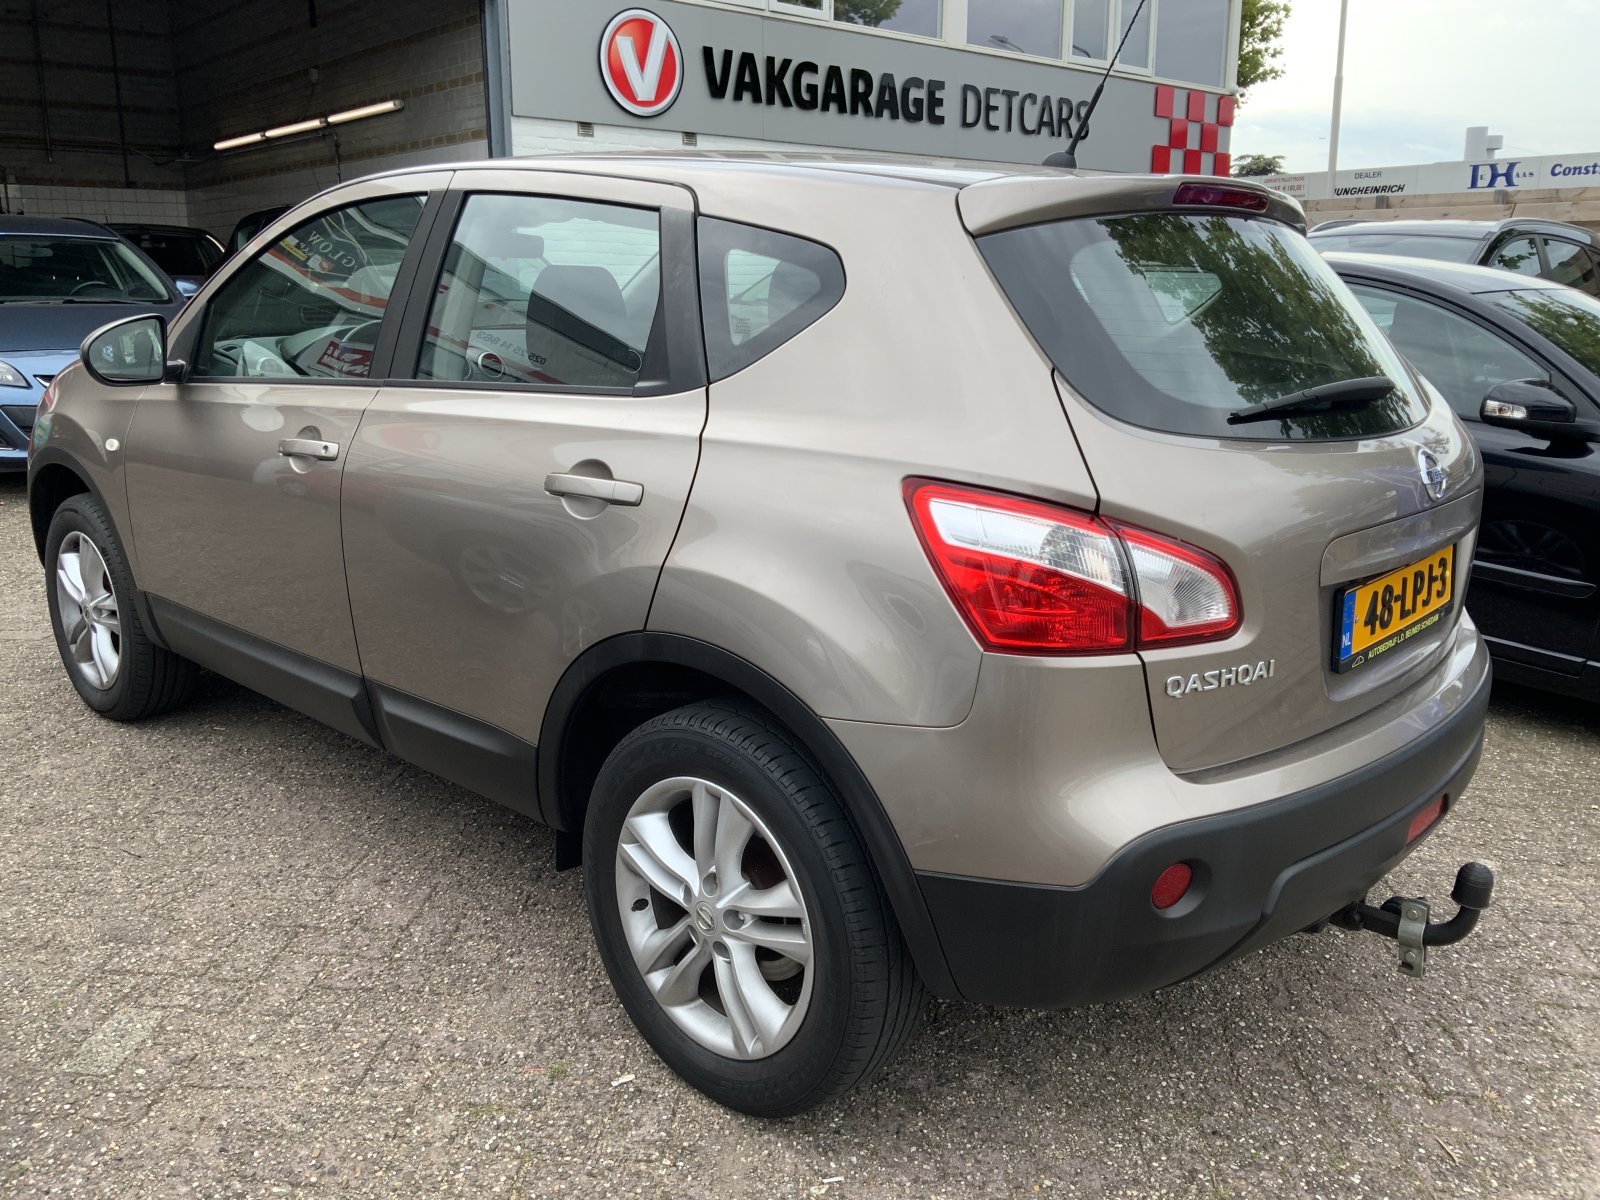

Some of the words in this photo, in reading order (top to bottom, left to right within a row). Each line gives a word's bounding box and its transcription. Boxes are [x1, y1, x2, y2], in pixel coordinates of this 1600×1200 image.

[703, 46, 945, 124] VAKGARAGE
[961, 83, 1090, 140] DETCARS
[1354, 171, 1382, 179] DEALER
[1551, 162, 1600, 177] Const
[1335, 184, 1405, 196] UNGHEINRICH
[1363, 556, 1448, 636] 48-LPJ-3
[1341, 632, 1352, 649] NL
[1165, 658, 1277, 698] QASHQAI
